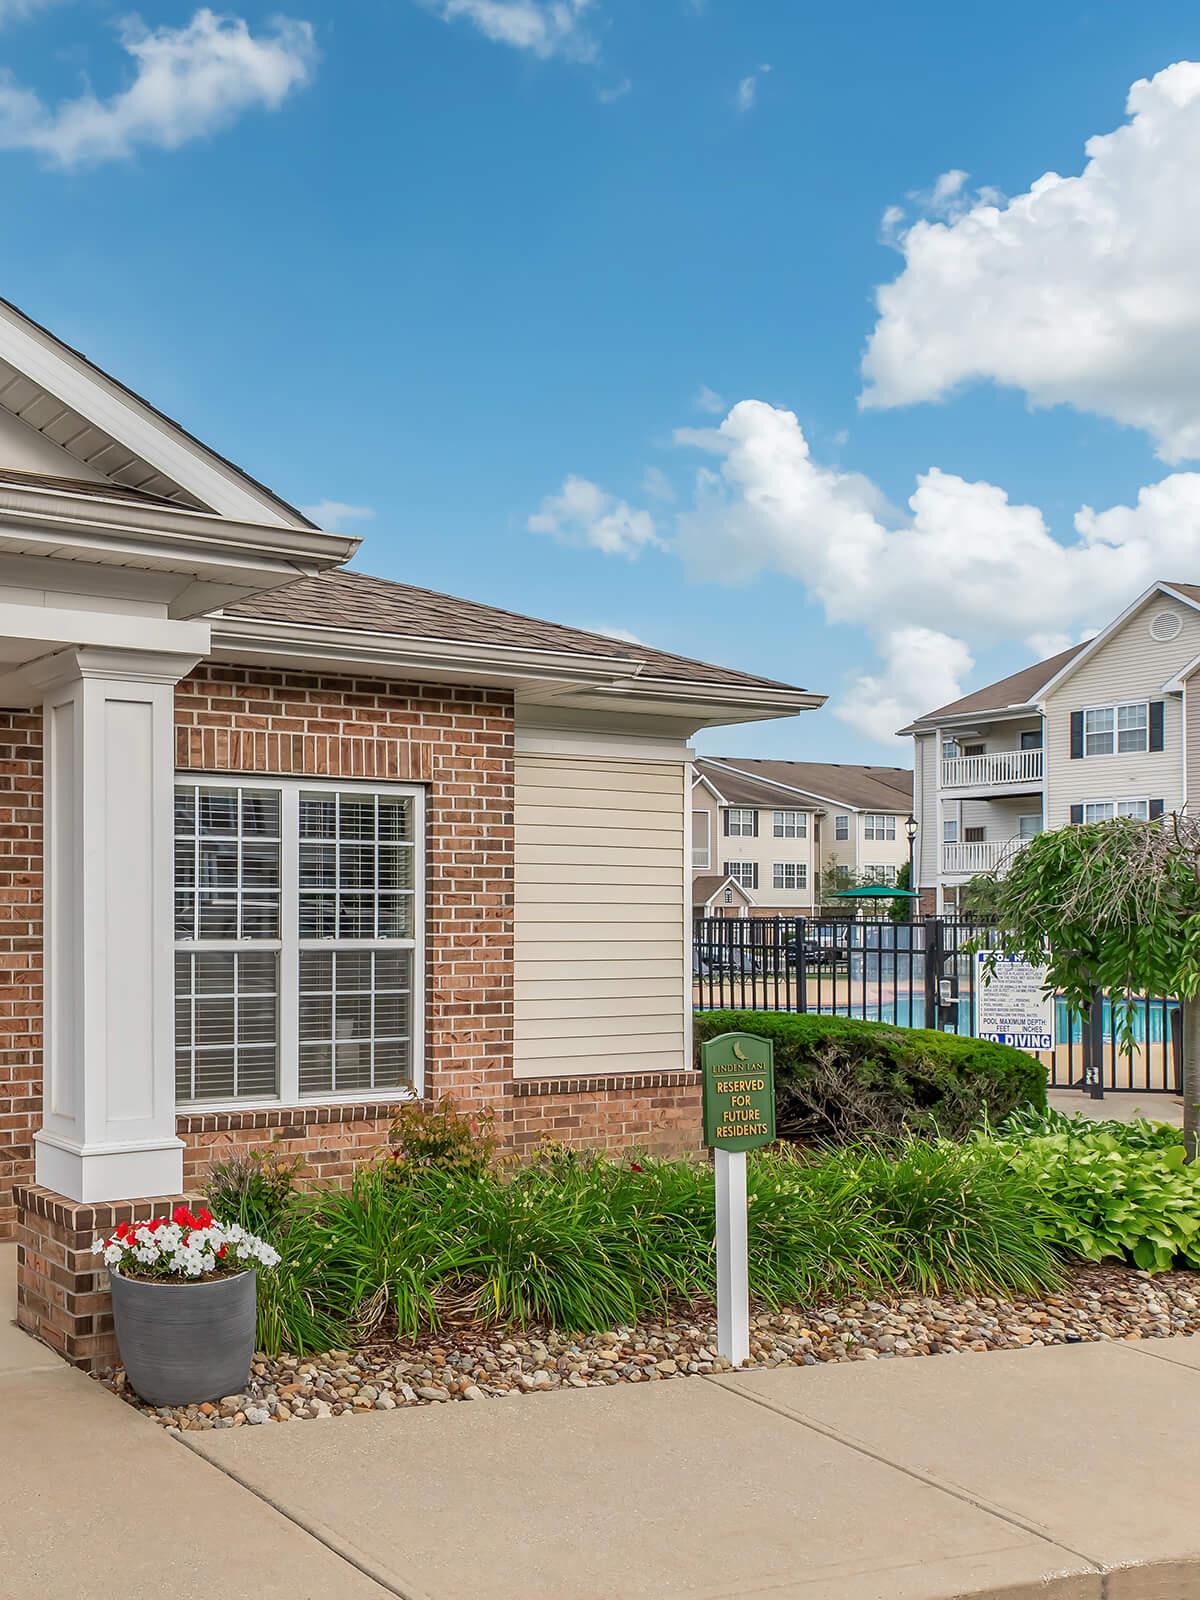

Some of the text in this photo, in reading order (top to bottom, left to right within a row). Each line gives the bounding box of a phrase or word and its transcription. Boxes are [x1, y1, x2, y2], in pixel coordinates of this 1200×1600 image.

[1022, 1025, 1043, 1033] INCHES
[1005, 1034, 1050, 1048] DIVING
[712, 1063, 744, 1073] LINDEN
[717, 1080, 765, 1094] RESERVED
[731, 1095, 751, 1107] FOR
[723, 1109, 760, 1122] FUTURE
[716, 1123, 768, 1138] RESIDENTS
